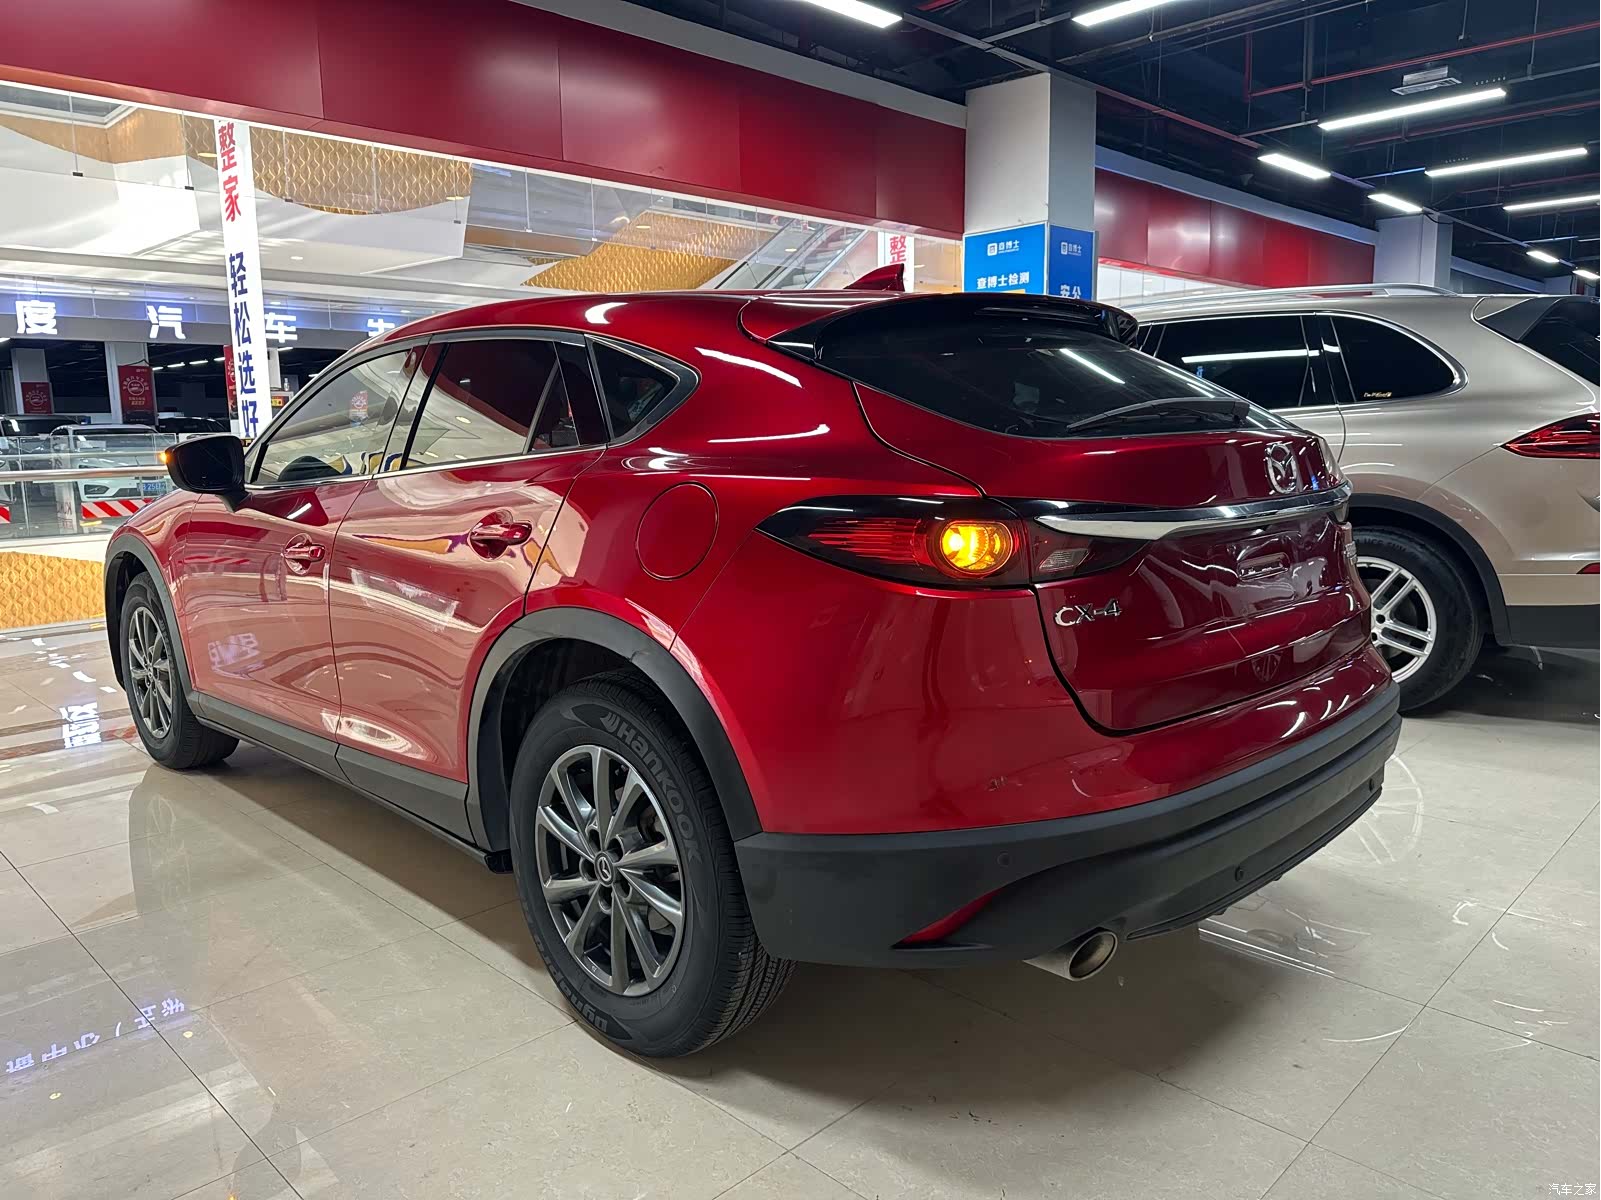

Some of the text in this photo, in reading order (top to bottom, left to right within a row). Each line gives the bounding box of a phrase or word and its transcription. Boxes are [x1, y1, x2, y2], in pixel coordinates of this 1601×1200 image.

[218, 122, 258, 438] 整家 轻松选好
[977, 272, 1030, 290] 查博士检测
[1054, 599, 1122, 627] CX-4
